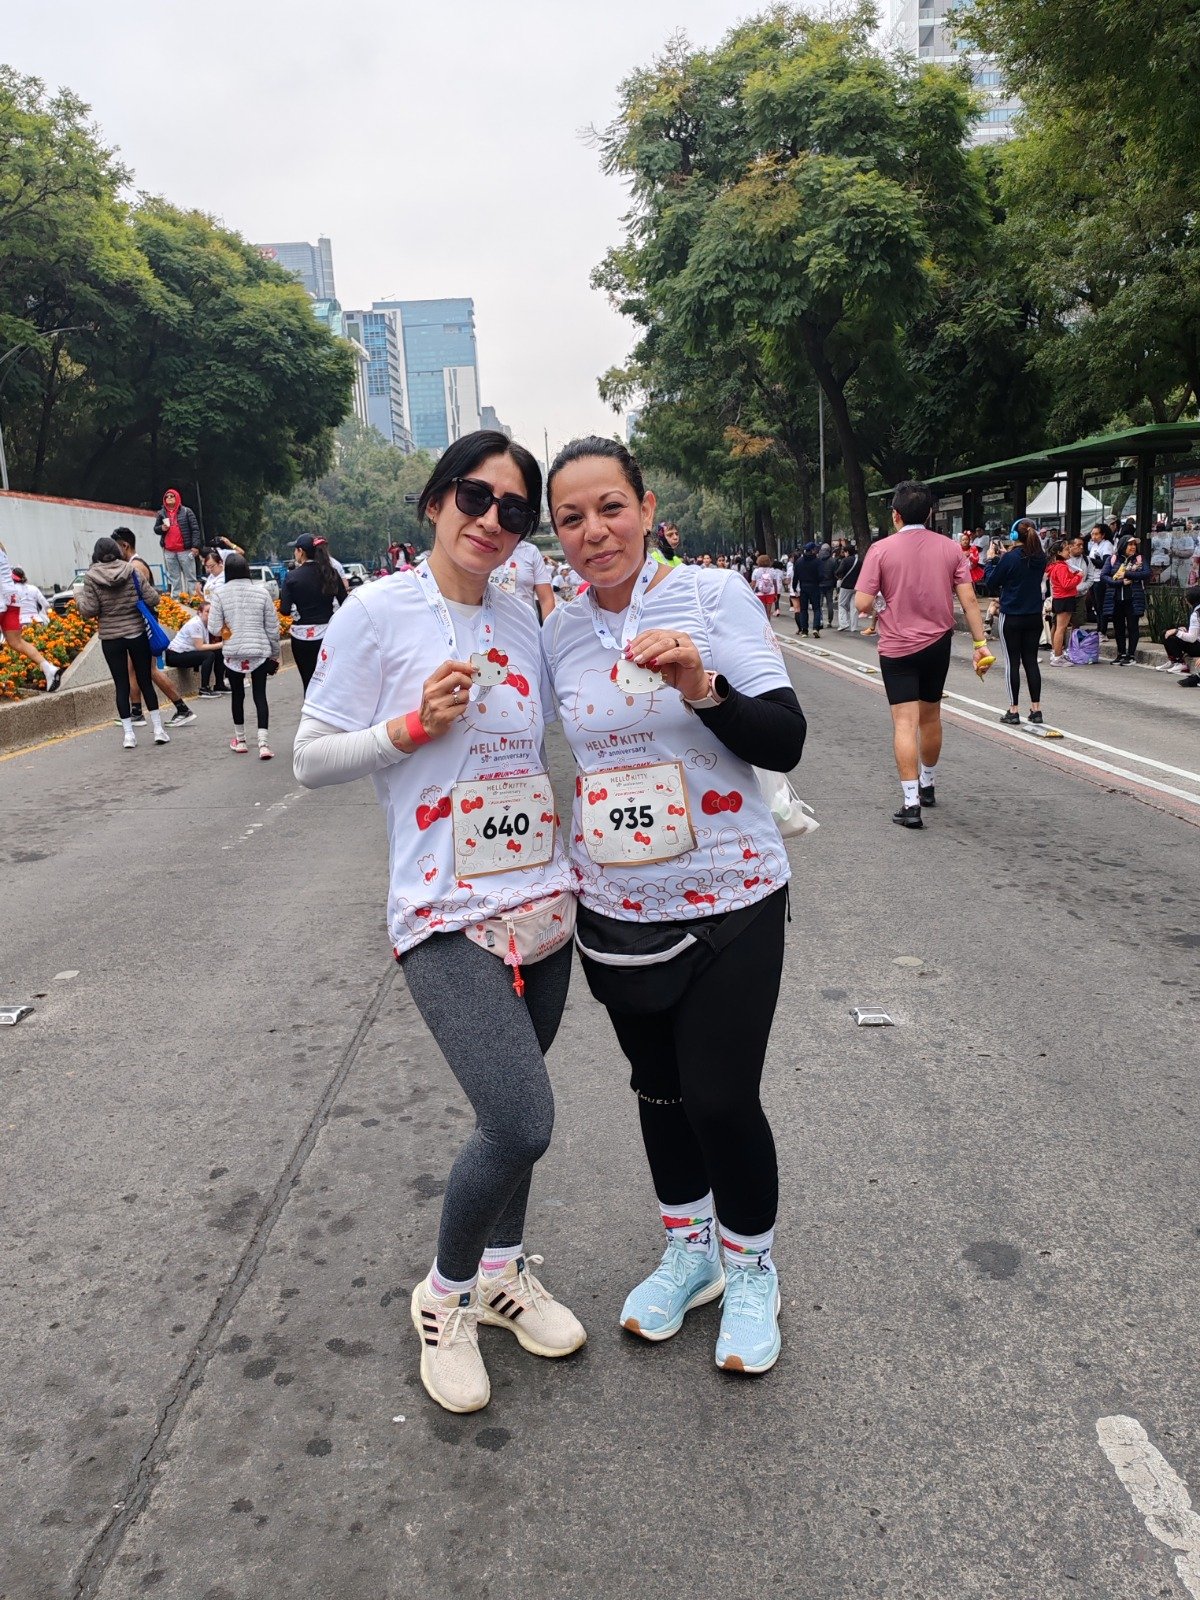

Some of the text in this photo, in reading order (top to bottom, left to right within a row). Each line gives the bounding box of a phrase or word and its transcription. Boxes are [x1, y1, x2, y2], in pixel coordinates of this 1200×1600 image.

[469, 738, 534, 755] HELLO KITT
[585, 732, 654, 751] HELLO KITTY
[493, 752, 530, 762] anniversary
[609, 745, 646, 756] anniversary
[487, 783, 508, 791] HELLO
[483, 813, 529, 839] 640
[609, 805, 654, 830] 935
